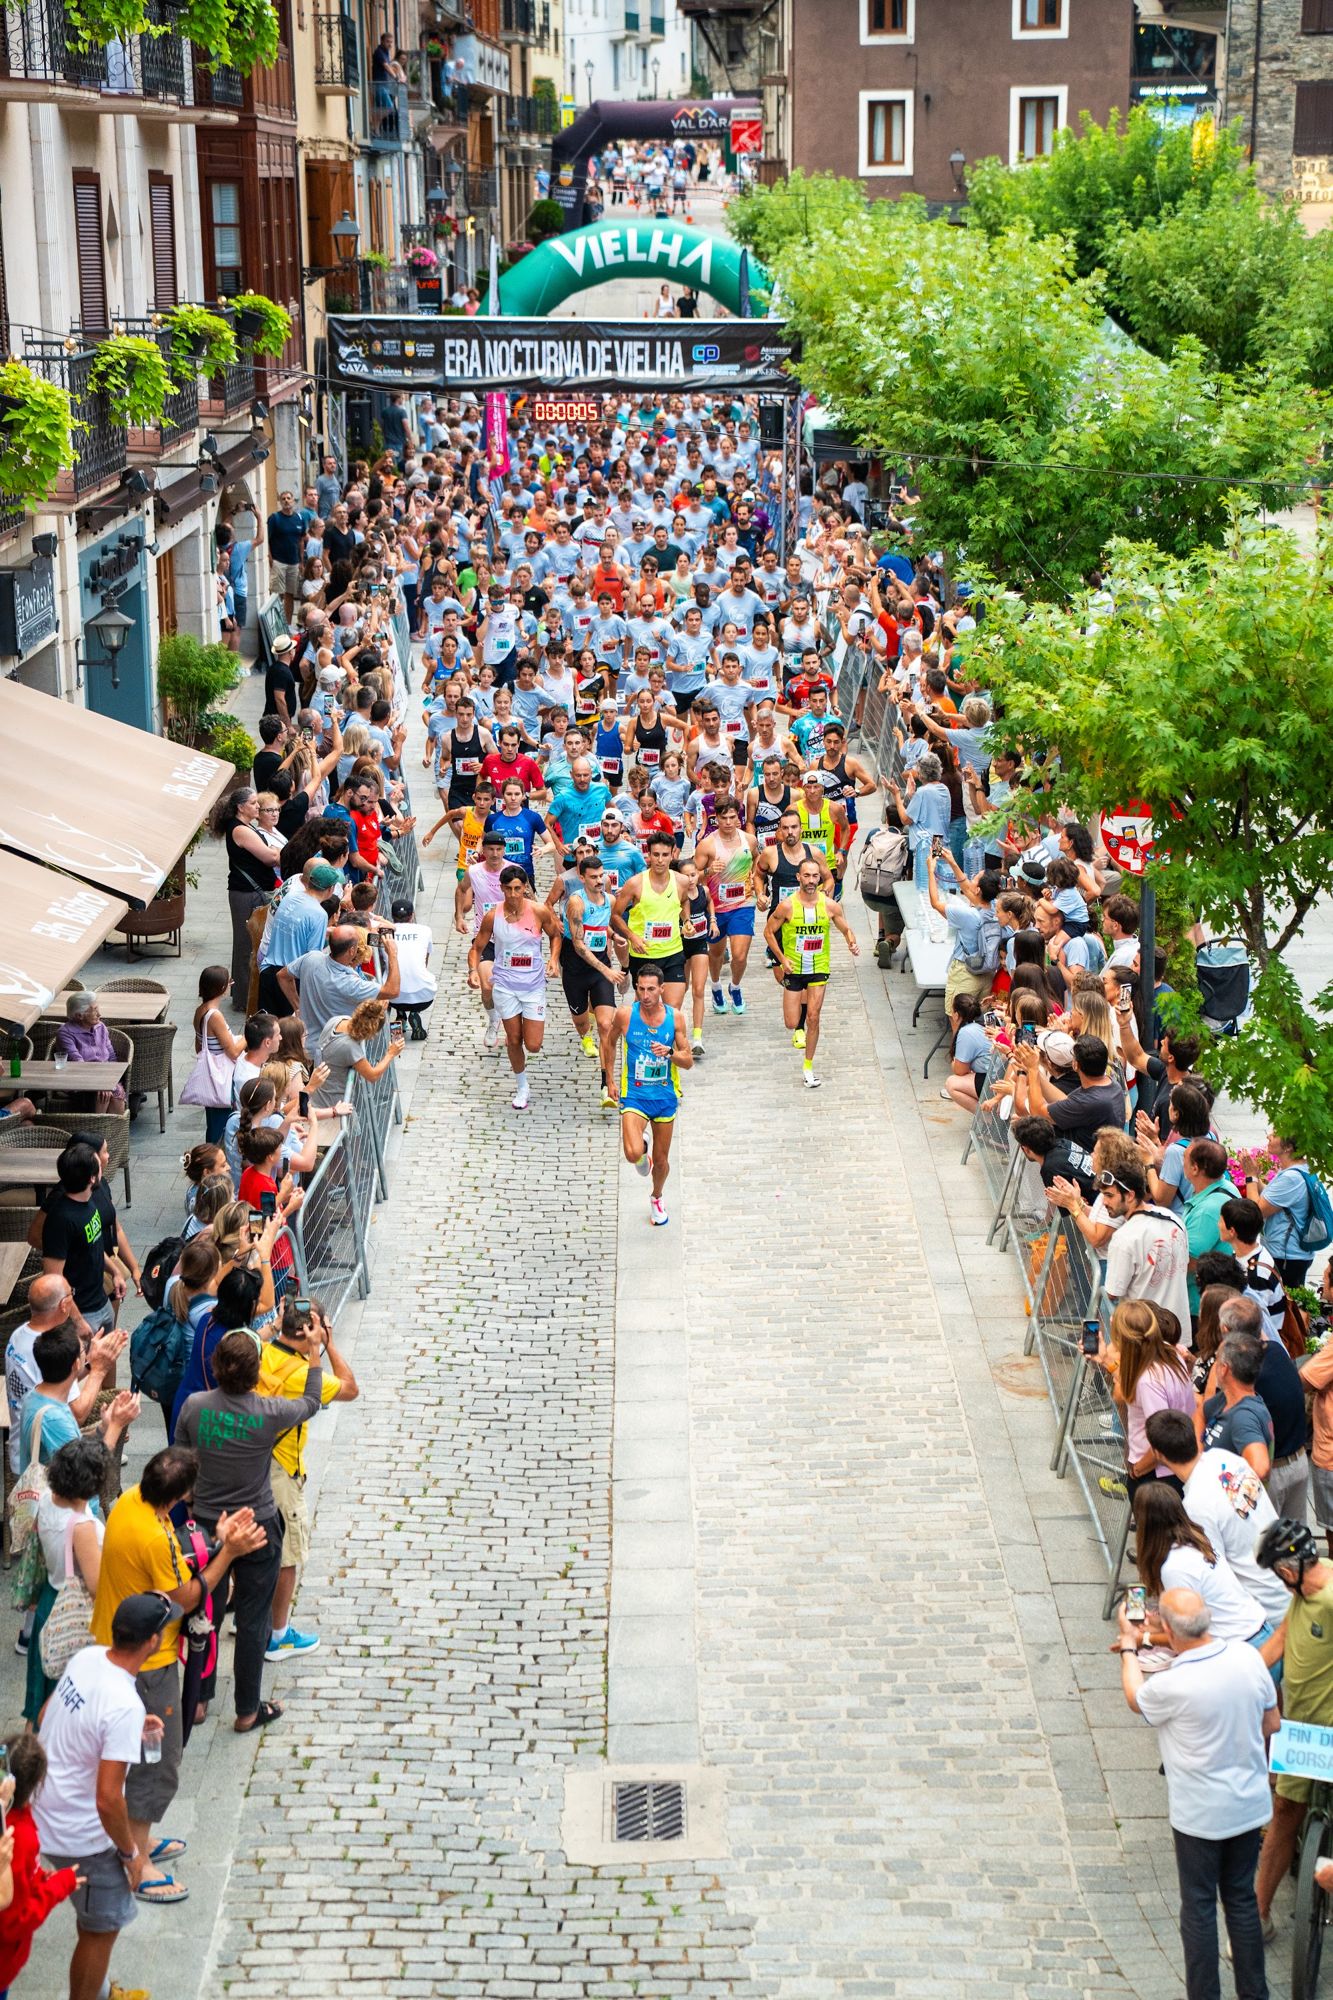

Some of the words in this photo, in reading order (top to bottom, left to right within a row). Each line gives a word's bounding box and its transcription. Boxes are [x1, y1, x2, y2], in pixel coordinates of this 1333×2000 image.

[671, 119, 696, 129] VAL
[550, 228, 712, 285] VIELHA
[444, 338, 483, 377] ERA
[484, 338, 585, 378] NOCTURNA
[586, 339, 613, 378] DE
[613, 340, 685, 378] VIELHA
[338, 363, 369, 373] CAVA
[509, 843, 520, 852] 50
[795, 925, 824, 934] IRWL
[395, 933, 418, 941] TAFF
[595, 938, 604, 947] 55
[511, 957, 531, 966] 1200
[650, 1067, 661, 1077] 74
[58, 1675, 86, 1714] STAFF
[1288, 1727, 1311, 1745] FIN
